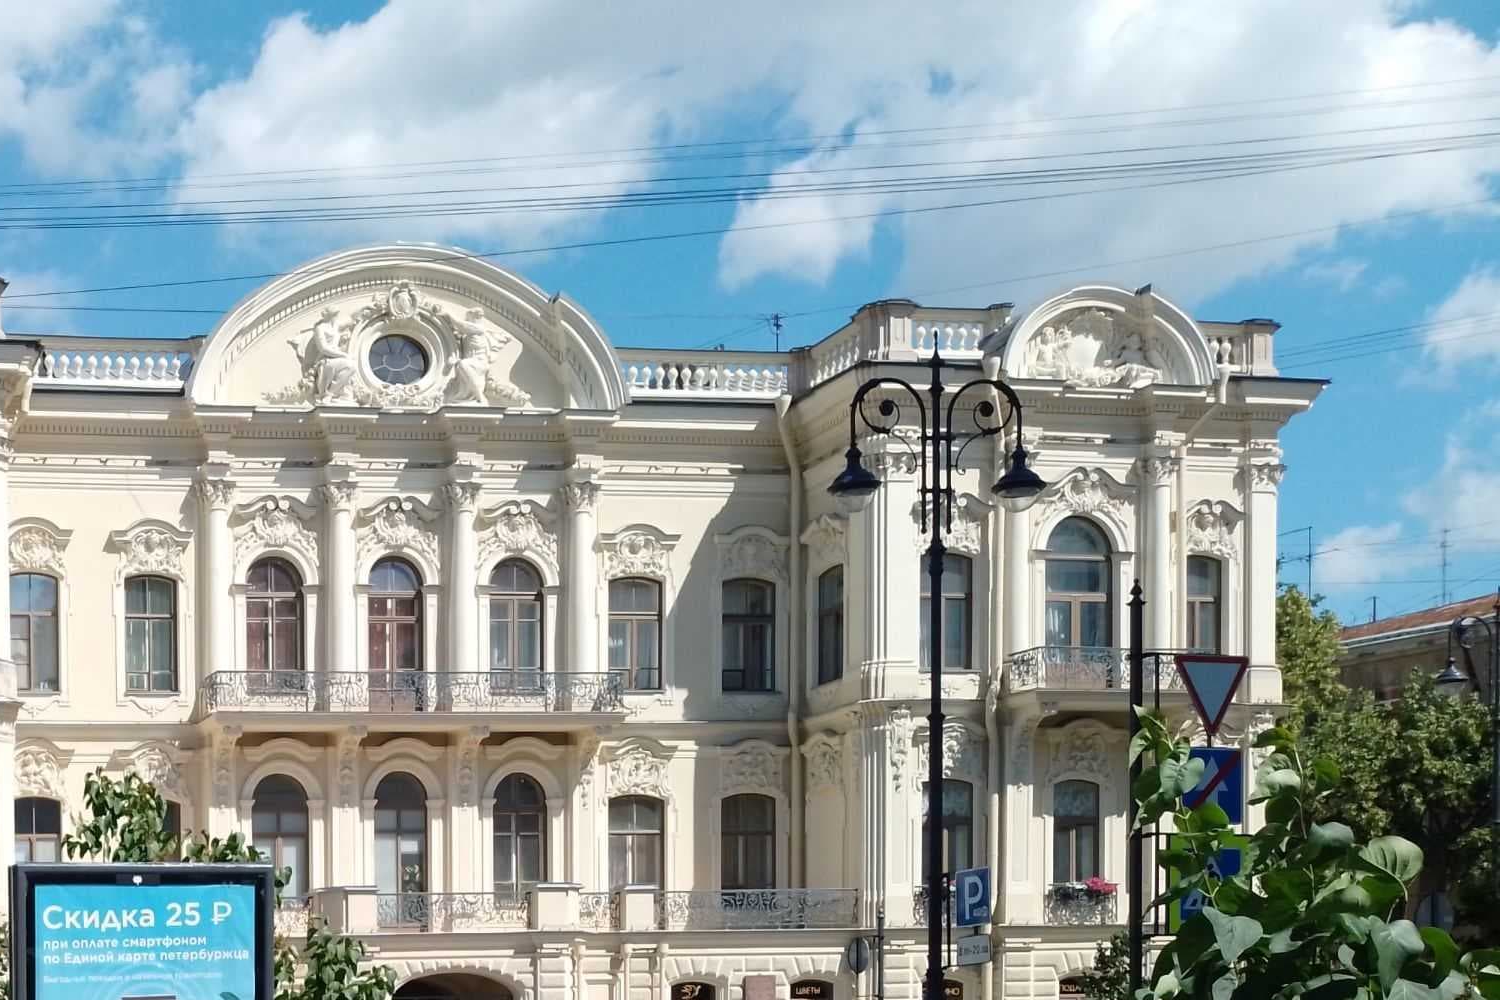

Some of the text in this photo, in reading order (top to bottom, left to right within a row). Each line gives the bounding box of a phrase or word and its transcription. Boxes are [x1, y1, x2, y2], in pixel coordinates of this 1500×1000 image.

[42, 904, 155, 931] Скидка
[165, 902, 201, 927] 25
[43, 936, 207, 951] при оплате смартфоном
[43, 949, 249, 965] по Единой карте петербуржца
